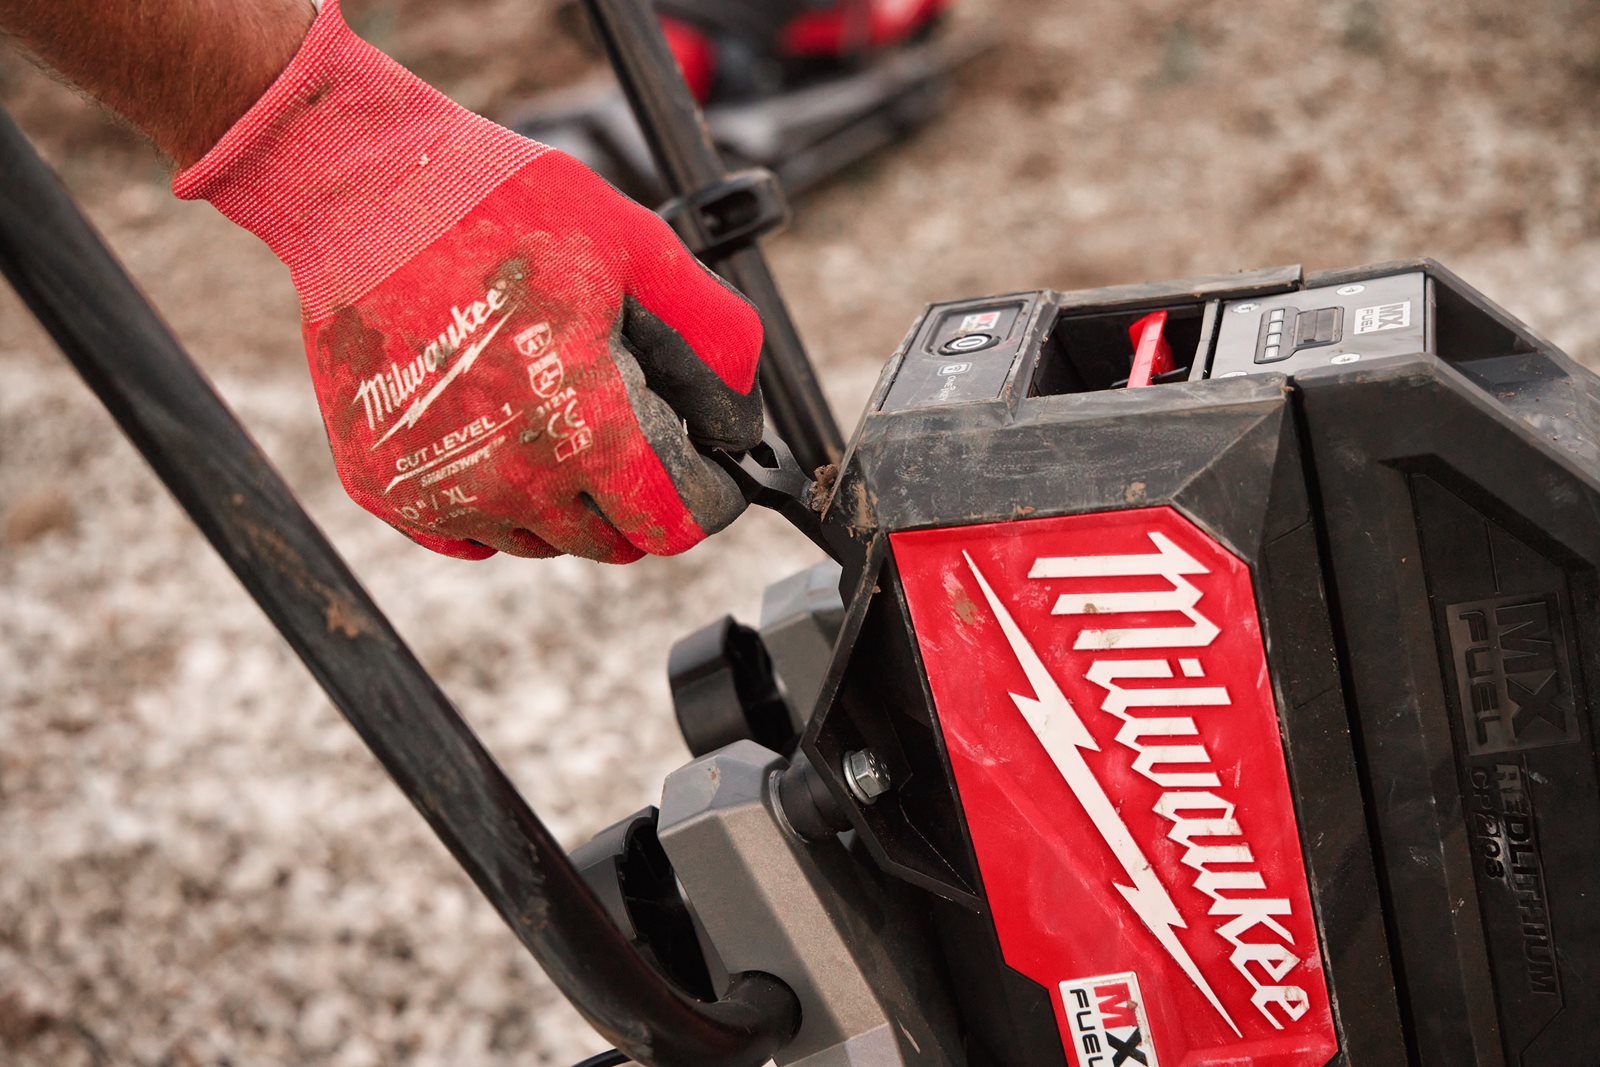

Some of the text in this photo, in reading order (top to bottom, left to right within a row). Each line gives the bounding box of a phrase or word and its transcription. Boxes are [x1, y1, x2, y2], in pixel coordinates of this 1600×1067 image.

[353, 285, 508, 430] Milwaukee
[1360, 308, 1374, 332] FUEL
[1378, 303, 1404, 329] MX
[396, 402, 512, 472] CUT LEVEL 1
[442, 486, 478, 505] XL
[1459, 609, 1502, 746] FUEL
[1495, 601, 1567, 739] MX
[1027, 531, 1311, 1030] Milwaukee
[1496, 764, 1559, 995] REDLITHIUM
[1093, 982, 1149, 1067] MX
